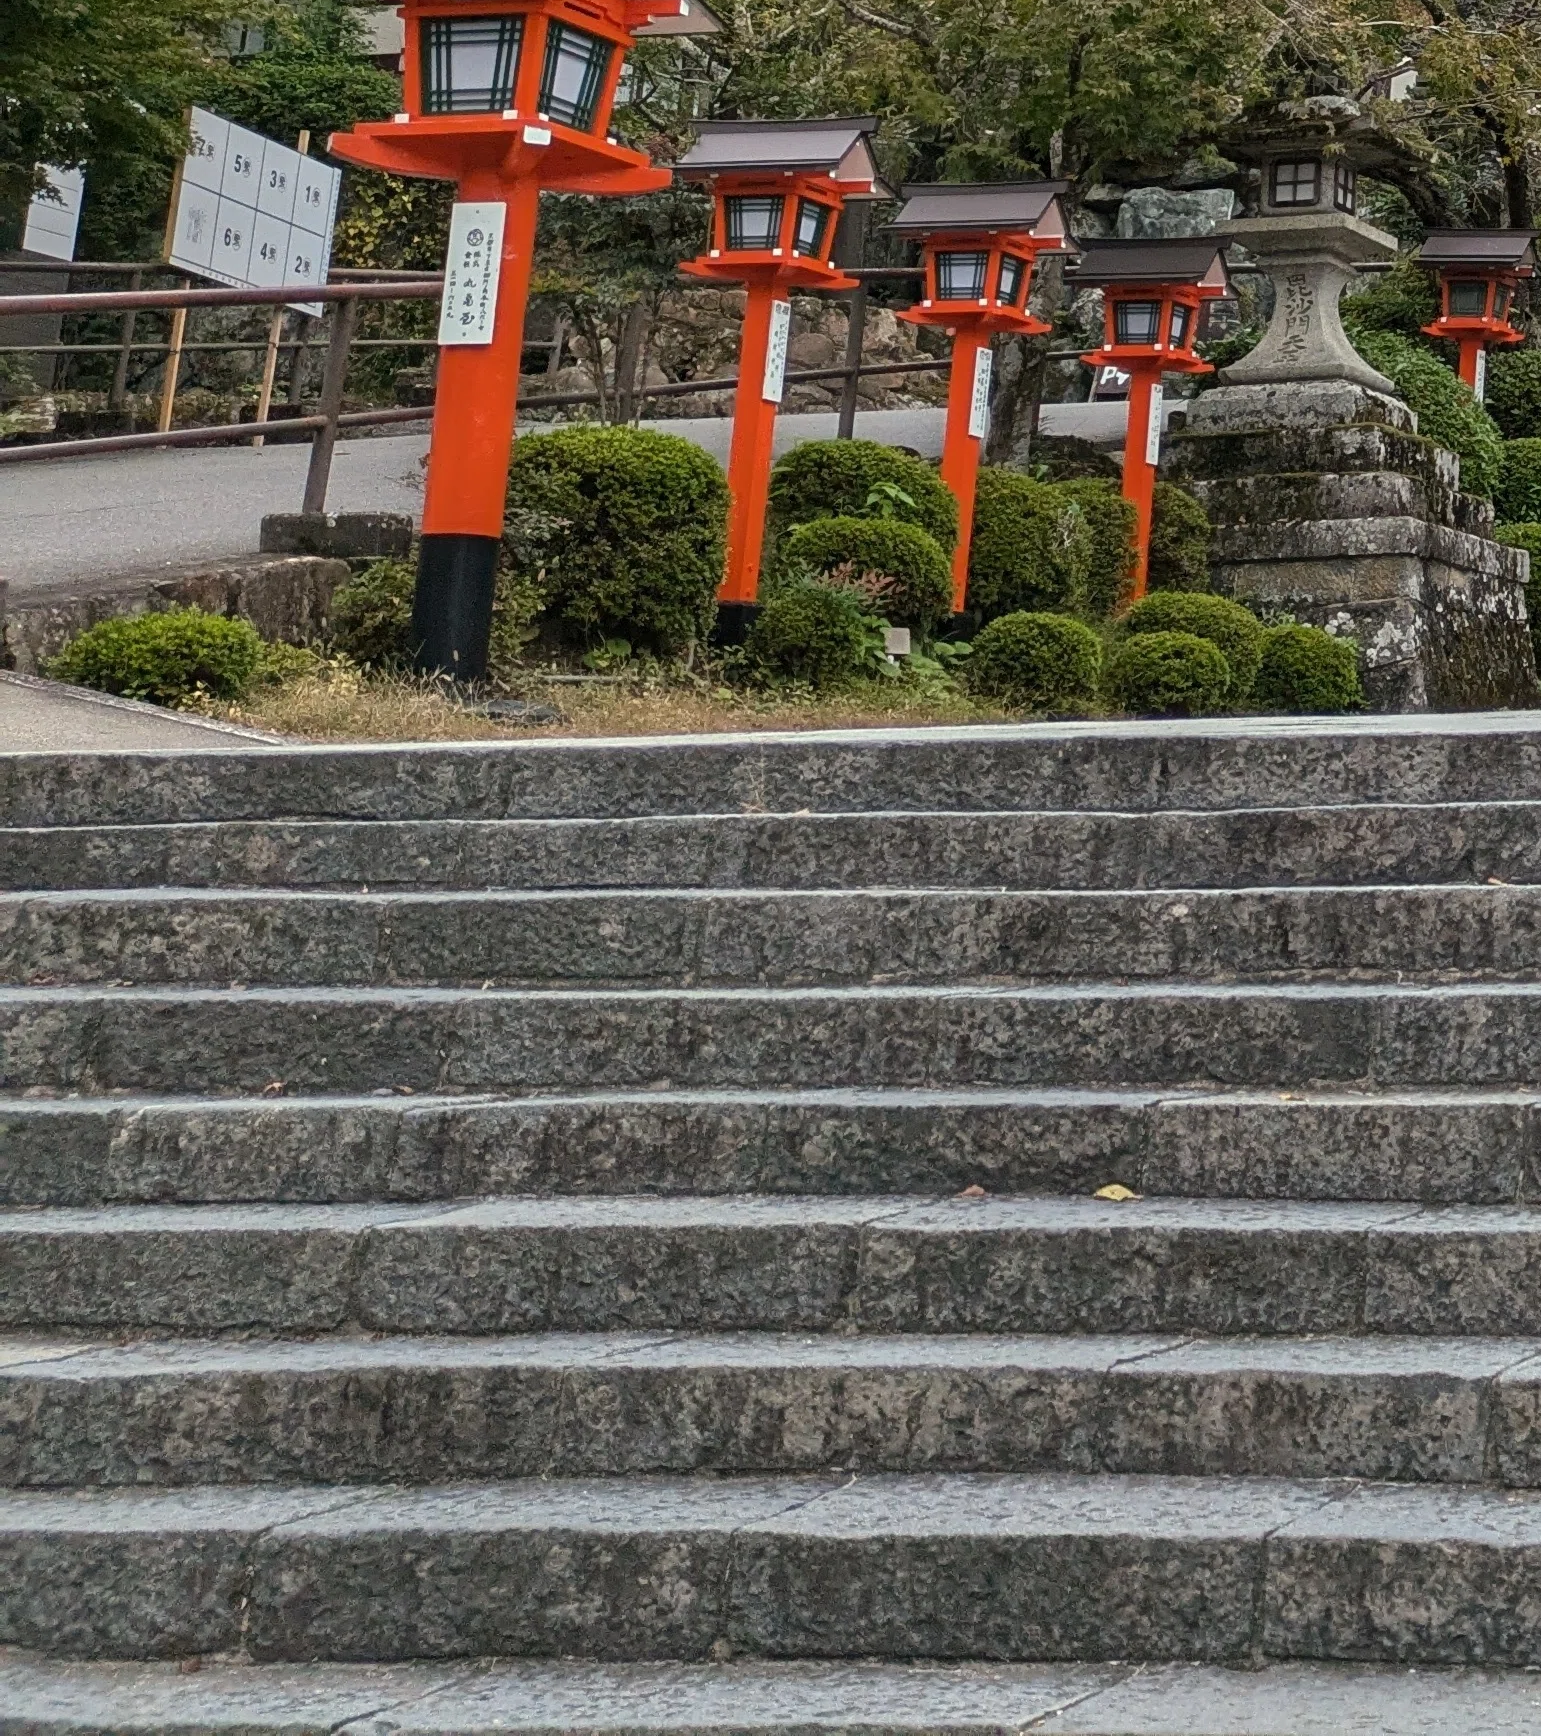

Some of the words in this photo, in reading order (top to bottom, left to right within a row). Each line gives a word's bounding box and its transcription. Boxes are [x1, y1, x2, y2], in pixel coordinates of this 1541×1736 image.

[234, 155, 242, 173] 5
[270, 170, 277, 188] 3
[305, 185, 311, 203] 1
[223, 227, 232, 247] 6
[260, 242, 268, 260] 4
[294, 255, 303, 274] 2
